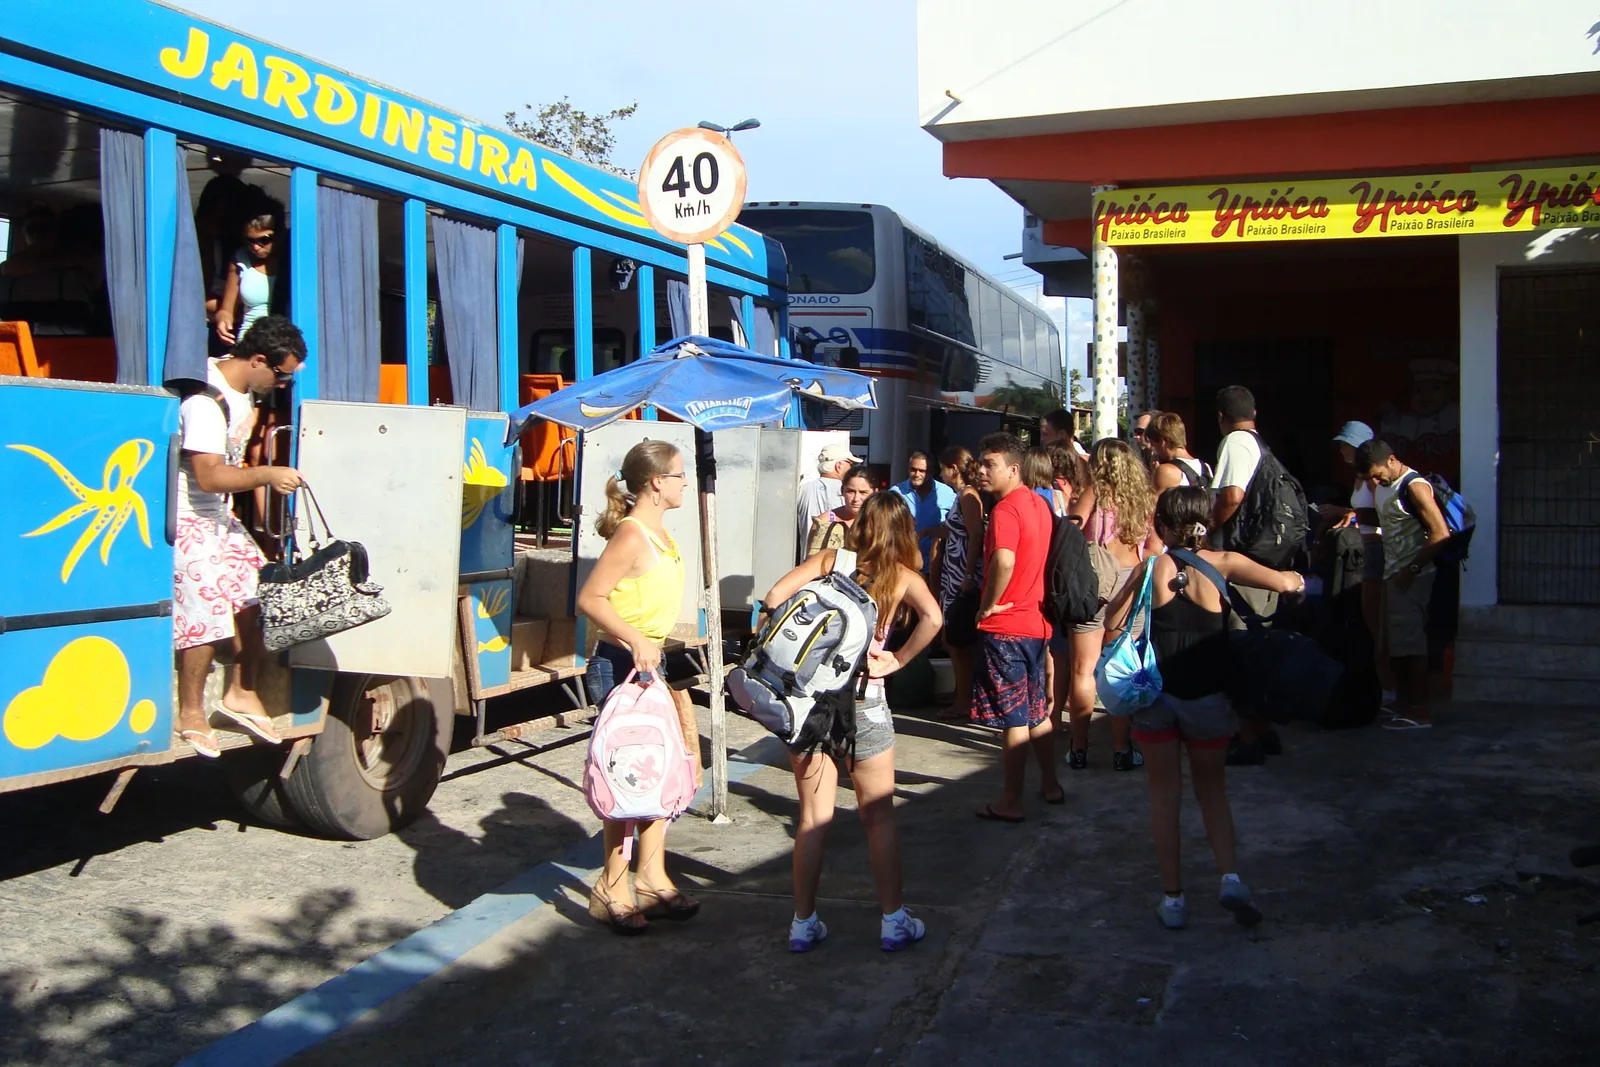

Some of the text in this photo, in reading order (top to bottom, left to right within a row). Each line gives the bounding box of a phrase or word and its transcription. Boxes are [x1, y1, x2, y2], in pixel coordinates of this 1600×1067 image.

[662, 151, 719, 198] 40
[1349, 180, 1479, 233] Ypióca
[1499, 171, 1600, 227] Ypió
[675, 199, 711, 219] Km/h
[1208, 187, 1330, 238] Ypióca
[1390, 218, 1475, 231] Paixão Brasileira
[1543, 211, 1600, 224] Paixão Bra
[1110, 228, 1186, 240] Paixão Brasileira
[1246, 223, 1327, 236] Paixão Brasileira
[788, 296, 840, 304] ONADO
